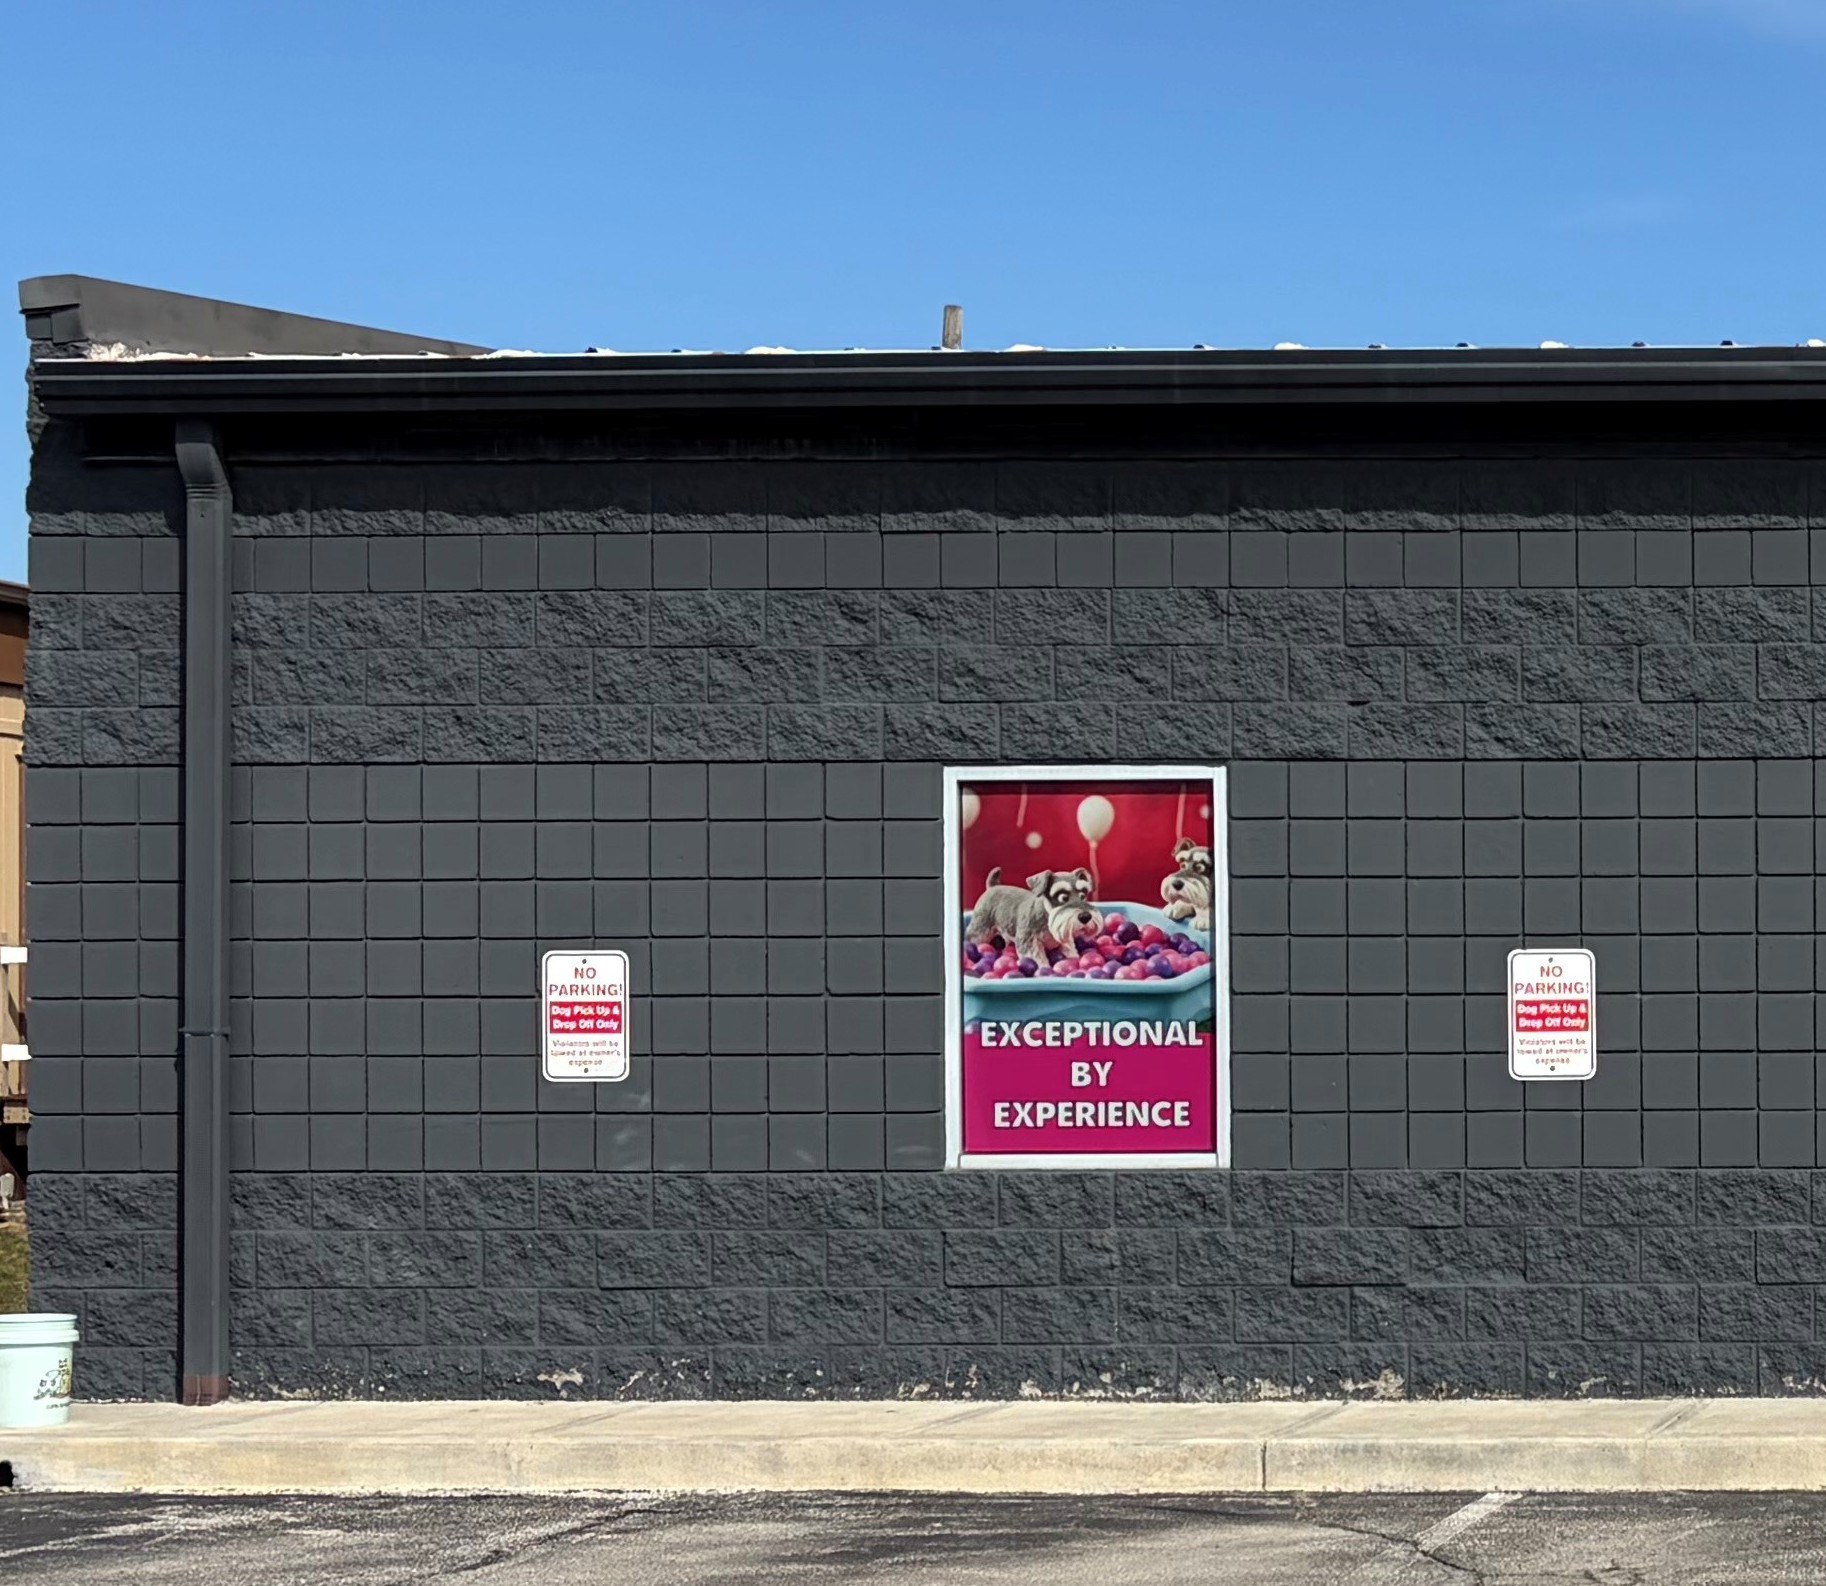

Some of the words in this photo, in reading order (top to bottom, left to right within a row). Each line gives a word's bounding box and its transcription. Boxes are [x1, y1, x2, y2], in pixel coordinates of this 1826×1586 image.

[574, 967, 597, 980] NO
[1540, 965, 1563, 978] NO
[549, 983, 623, 997] PARKING!
[1514, 981, 1589, 995] PARKING!
[551, 1005, 571, 1017] Dog
[573, 1005, 595, 1015] Pick
[596, 1005, 611, 1017] Up
[612, 1005, 620, 1015] &
[1517, 1003, 1538, 1015] Dog
[1539, 1003, 1561, 1014] Pick
[1562, 1003, 1578, 1014] Up
[1578, 1003, 1587, 1014] &
[553, 1019, 577, 1030] Drop
[578, 1019, 594, 1029] Off
[595, 1019, 619, 1030] Only
[1518, 1017, 1543, 1029] Drop
[1545, 1017, 1562, 1028] Off
[1562, 1017, 1586, 1028] Only
[980, 1020, 1204, 1048] EXCEPTIONAL
[1070, 1060, 1114, 1088] BY
[993, 1100, 1191, 1128] EXPERIENCE
